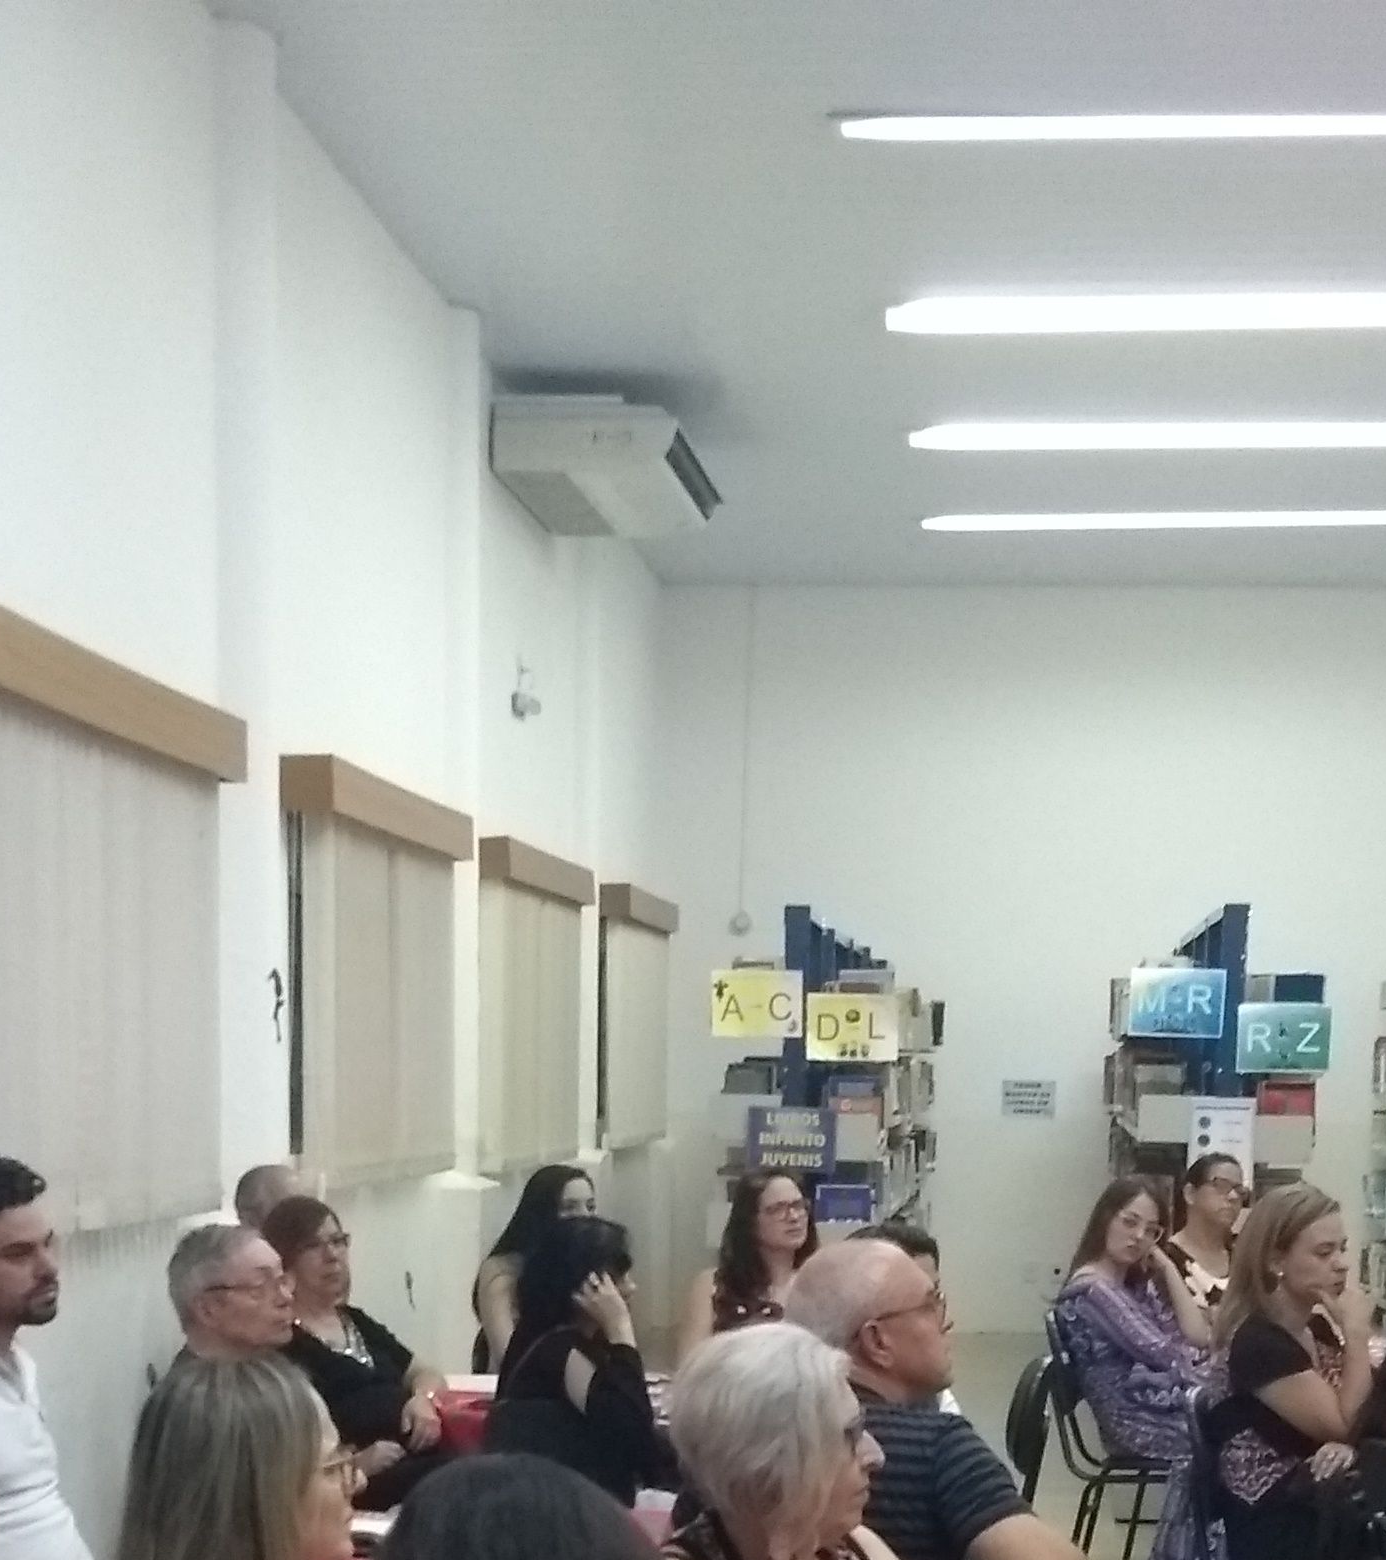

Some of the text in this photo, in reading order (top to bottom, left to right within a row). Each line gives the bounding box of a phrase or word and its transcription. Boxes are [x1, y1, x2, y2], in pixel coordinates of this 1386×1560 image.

[721, 994, 744, 1022] A
[768, 992, 793, 1021] C
[1137, 986, 1166, 1013] M
[1187, 984, 1212, 1014] R
[817, 1013, 840, 1041] D
[868, 1012, 885, 1040] L
[1246, 1021, 1321, 1053] R Z
[766, 1111, 820, 1126] LIVROS
[758, 1132, 826, 1148] INFANTO
[759, 1152, 823, 1168] JUVENIS
